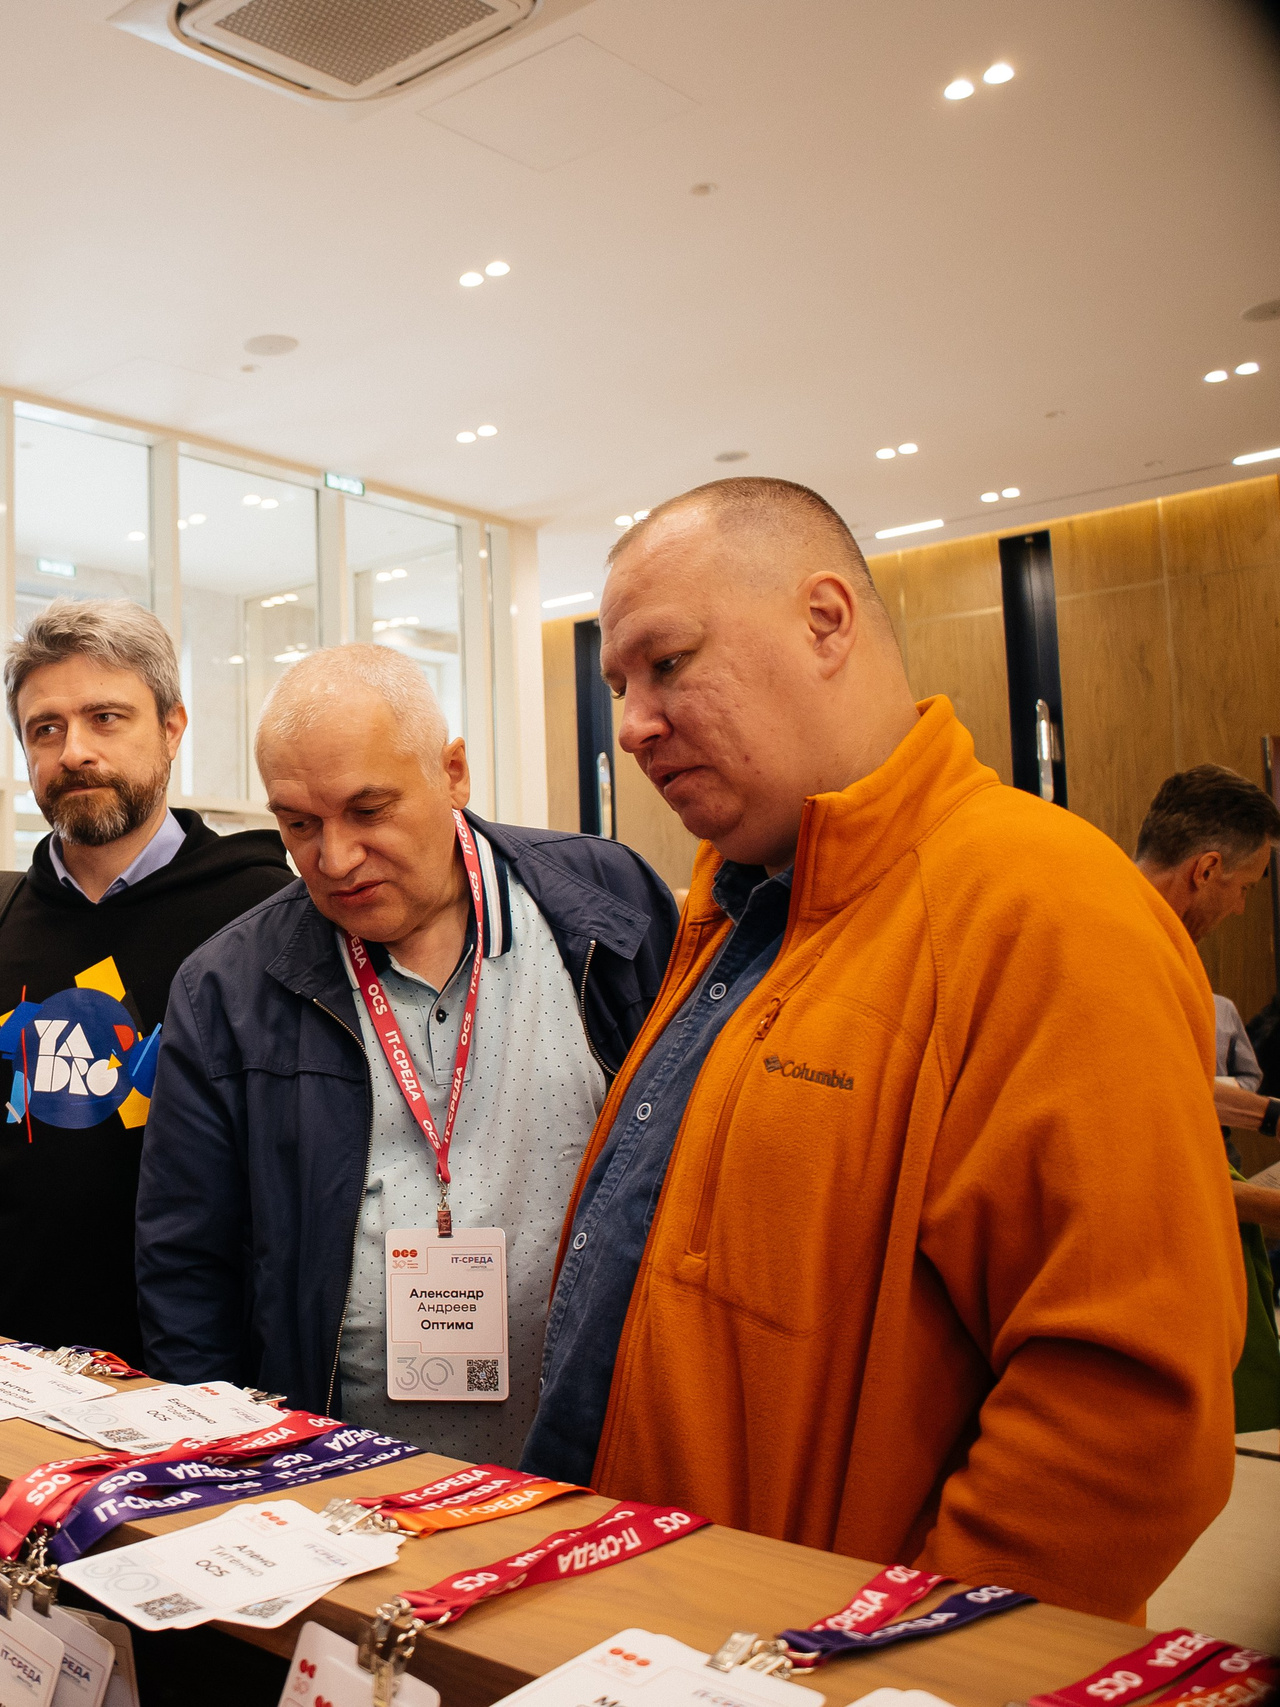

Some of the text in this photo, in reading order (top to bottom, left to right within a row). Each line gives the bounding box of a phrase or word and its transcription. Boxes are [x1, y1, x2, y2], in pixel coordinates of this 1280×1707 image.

[469, 871, 480, 901] OCS
[368, 983, 388, 1015] OCS
[461, 1012, 472, 1045] OCS
[385, 1030, 421, 1101] IT-СРЕДА
[782, 1060, 854, 1090] Columbia
[423, 1120, 441, 1149] OCS
[451, 1256, 494, 1265] IT-СРЕДА
[409, 1288, 484, 1300] Александр
[417, 1302, 477, 1315] Андреев
[420, 1319, 474, 1330] Оптима
[395, 1357, 454, 1391] 30
[147, 1409, 171, 1422] OCS
[167, 1397, 217, 1424] Екатерина
[166, 1461, 262, 1480] IT-СРЕДА
[273, 1453, 314, 1469] OCS
[26, 1473, 72, 1506] OCS
[97, 1471, 148, 1495] OCS
[218, 1481, 262, 1491] OCS
[403, 1467, 492, 1503] IT-СРЕДА
[420, 1478, 511, 1511] IT-СРЕДА
[93, 1490, 203, 1523] IT-СРЕДА
[446, 1488, 543, 1519] IT-СРЕДА
[653, 1511, 692, 1534] OCS
[233, 1544, 278, 1568] Алена
[557, 1526, 642, 1573] IT-СРЕДА
[195, 1559, 231, 1578] OCS
[451, 1571, 500, 1592] OCS
[0, 1648, 42, 1685] IT-СРЕДА
[62, 1655, 91, 1682] РЕДА
[1086, 1670, 1143, 1701] OCS
